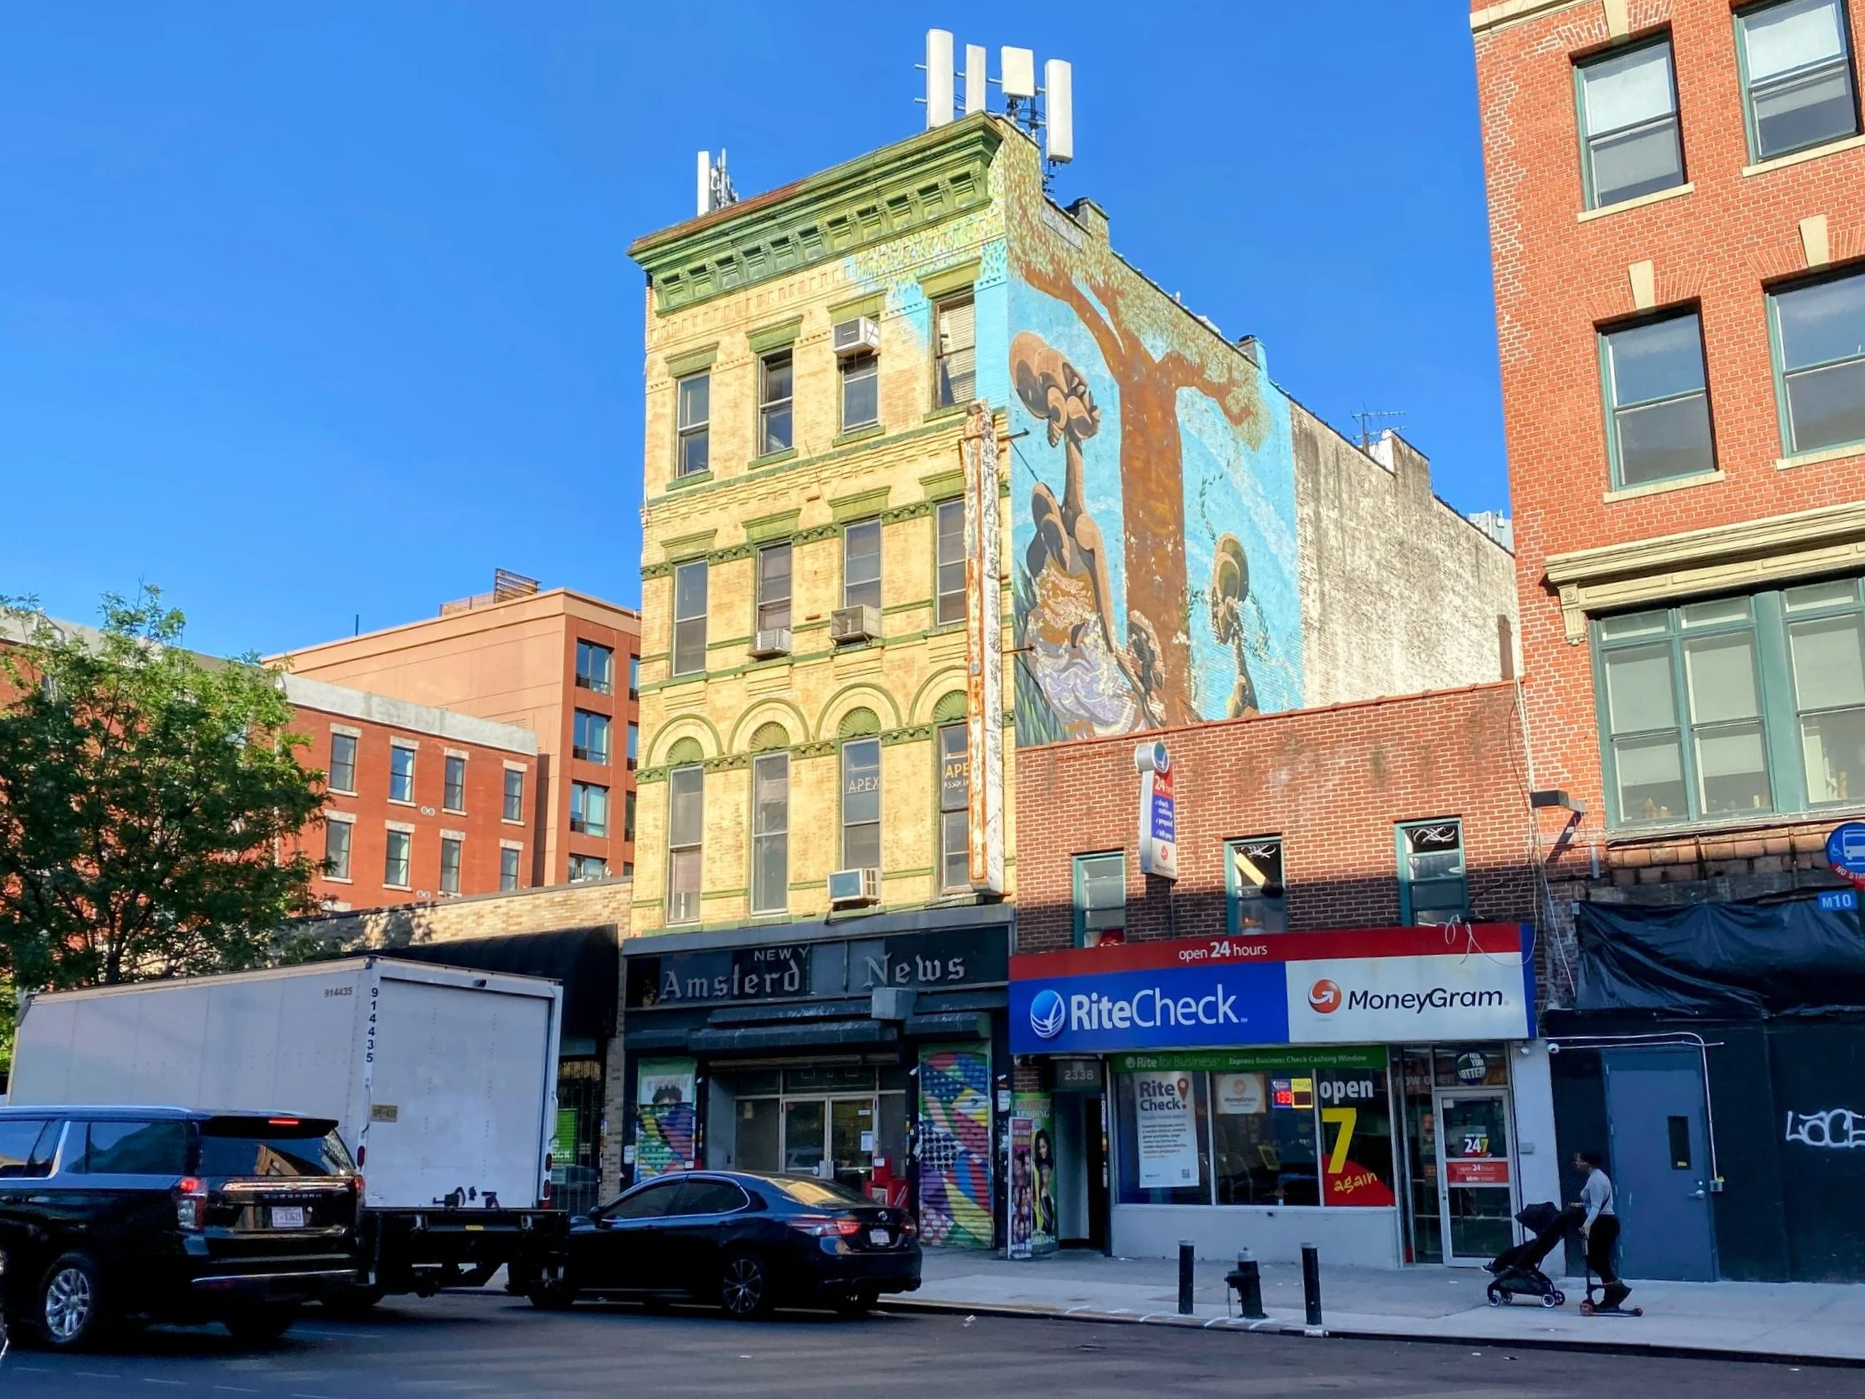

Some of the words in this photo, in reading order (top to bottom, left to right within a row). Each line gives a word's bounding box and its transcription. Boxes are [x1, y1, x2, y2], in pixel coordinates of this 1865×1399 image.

[848, 776, 879, 793] APEX
[1154, 775, 1166, 791] 24
[1835, 865, 1847, 876] NO
[1821, 894, 1852, 909] M10
[754, 948, 793, 961] NEW
[797, 946, 810, 959] Y
[1178, 949, 1208, 963] open
[1210, 941, 1231, 958] 24
[1233, 943, 1268, 957] hours
[658, 959, 800, 1000] Amsterd
[862, 952, 966, 988] News
[324, 987, 353, 998] 914435
[1348, 988, 1503, 1014] MoneyGram
[1070, 984, 1240, 1031] RiteCheck
[366, 987, 379, 1063] 914435
[1136, 1056, 1157, 1068] Rite
[1159, 1055, 1172, 1067] for
[1173, 1055, 1217, 1067] Business
[1228, 1057, 1255, 1066] Express
[1255, 1056, 1285, 1064] Business
[1286, 1055, 1307, 1063] Check
[1308, 1055, 1337, 1064] Cashing
[1337, 1054, 1367, 1062] Window
[1064, 1069, 1094, 1081] 2338
[1139, 1080, 1176, 1098] Rite
[1319, 1080, 1374, 1104] open
[1140, 1097, 1181, 1112] Check
[1321, 1107, 1357, 1174] 7
[1333, 1172, 1378, 1194] again
